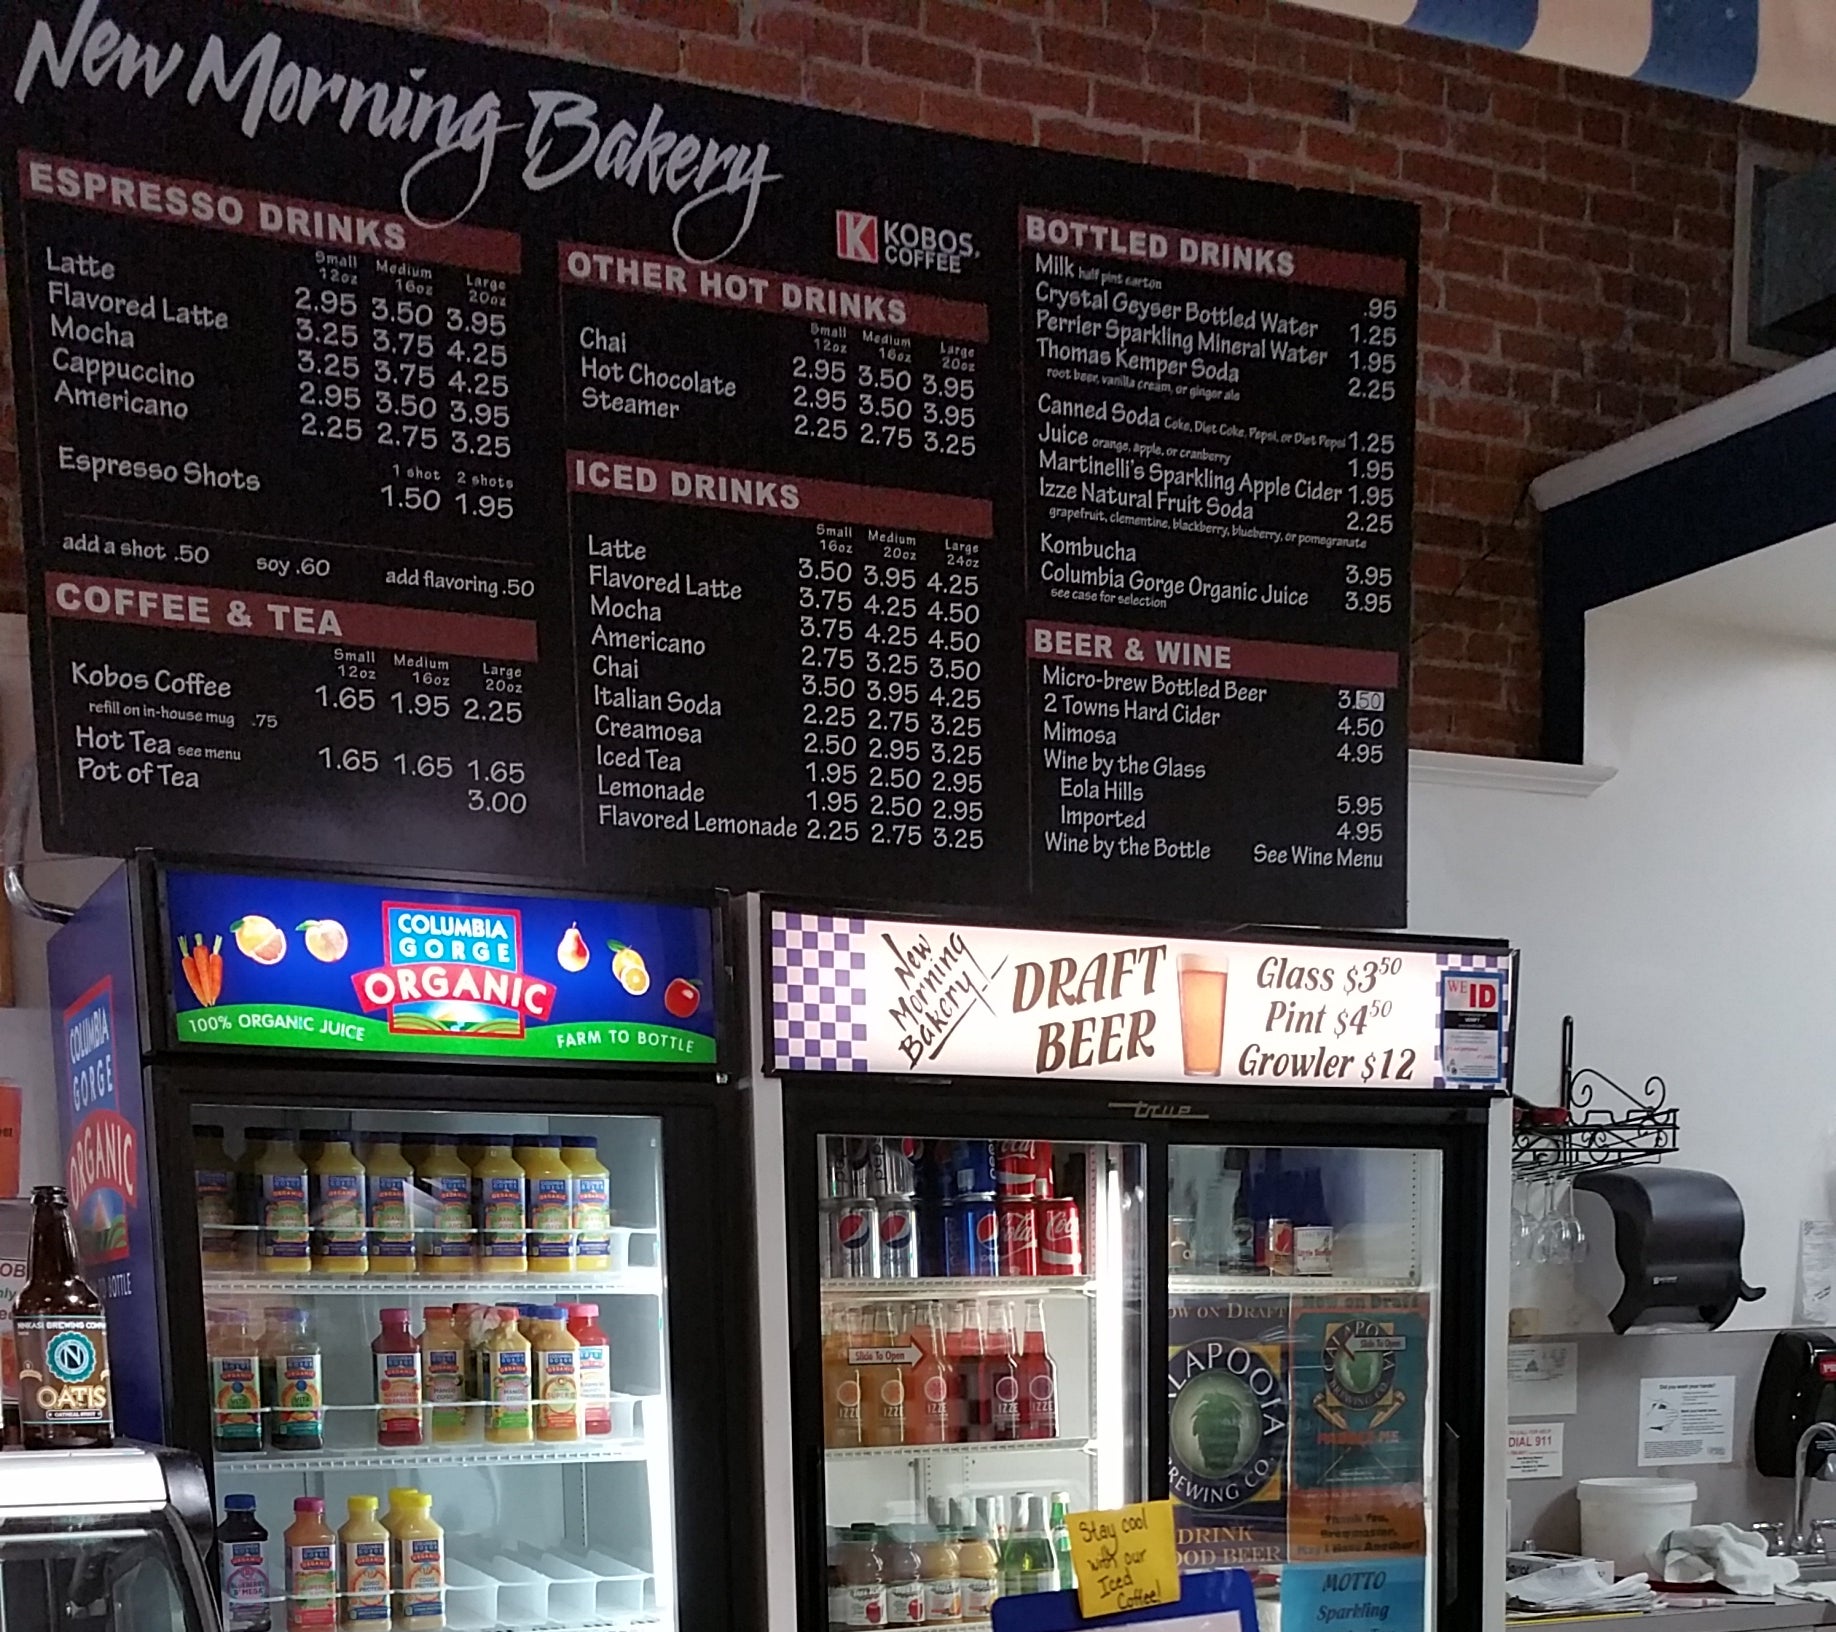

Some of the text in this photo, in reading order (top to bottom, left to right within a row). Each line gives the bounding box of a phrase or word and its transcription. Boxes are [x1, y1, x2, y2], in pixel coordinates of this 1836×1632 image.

[14, 0, 783, 264] New Morning Bakery
[30, 161, 406, 250] ESPRESSO DRINKS
[885, 247, 961, 273] COFFEE
[1027, 215, 1294, 276] BOTTLED DRINKS
[47, 247, 506, 336] Latte 2.95 3.50 3.95
[568, 251, 906, 327] OTHER HOT DRINKS
[1036, 281, 1396, 347] Crystal Geyser Bottled Water 1.25
[53, 347, 194, 389] Cappuccino
[582, 356, 735, 396] Hot Chocolate
[55, 380, 188, 419] Americano
[583, 387, 847, 440] Steamer 2.25
[59, 446, 513, 518] Espresso Shots 1.50 1.95
[577, 460, 799, 509] ICED DRINKS
[1040, 449, 1393, 507] Martinelli's Sparkling Apple Cider 1.95
[1041, 533, 1136, 561] Kombucha
[386, 568, 534, 598] add flavoring .50
[56, 583, 342, 636] COFFEE & TEA
[1035, 629, 1231, 669] BEER & WINE
[72, 662, 230, 697] Kobos Coffee
[1044, 665, 1147, 692] Micro-brew
[1152, 675, 1219, 698] Bottled
[1225, 681, 1267, 702] Beer
[89, 700, 277, 728] refill on in-house mug .75
[1044, 720, 1383, 763] Mimosa 4.95
[600, 805, 797, 837] Flavored Lemonade
[397, 913, 508, 941] COLUMBIA
[399, 937, 511, 964] GORGE
[364, 965, 547, 1016] ORGANIC
[1013, 944, 1167, 1014] DRAFT
[1257, 956, 1335, 991] Glass
[1447, 980, 1468, 993] WE
[1469, 984, 1496, 1008] ID
[187, 1013, 365, 1042] 100% ORGANIC JUICE
[1265, 1000, 1327, 1034] Pint
[69, 1007, 109, 1064] COLUMBIA
[557, 1029, 694, 1053] FARM TO BOTTLE
[1036, 1009, 1156, 1074] BEER
[1239, 1043, 1416, 1083] Growler $12
[73, 1054, 113, 1112] GORGE
[70, 1120, 134, 1211] ORGANIC
[875, 1351, 884, 1361] To
[886, 1351, 905, 1362] Open
[37, 1385, 107, 1409] OATIS
[1508, 1436, 1552, 1447] DIAL 911
[1122, 1508, 1148, 1533] cool
[1178, 1527, 1252, 1545] DRINK
[1124, 1549, 1146, 1565] our
[1223, 1547, 1282, 1564] BEER
[1098, 1568, 1133, 1599] Iced
[1322, 1571, 1387, 1592] MOTTO
[1317, 1603, 1390, 1623] Sparkling
